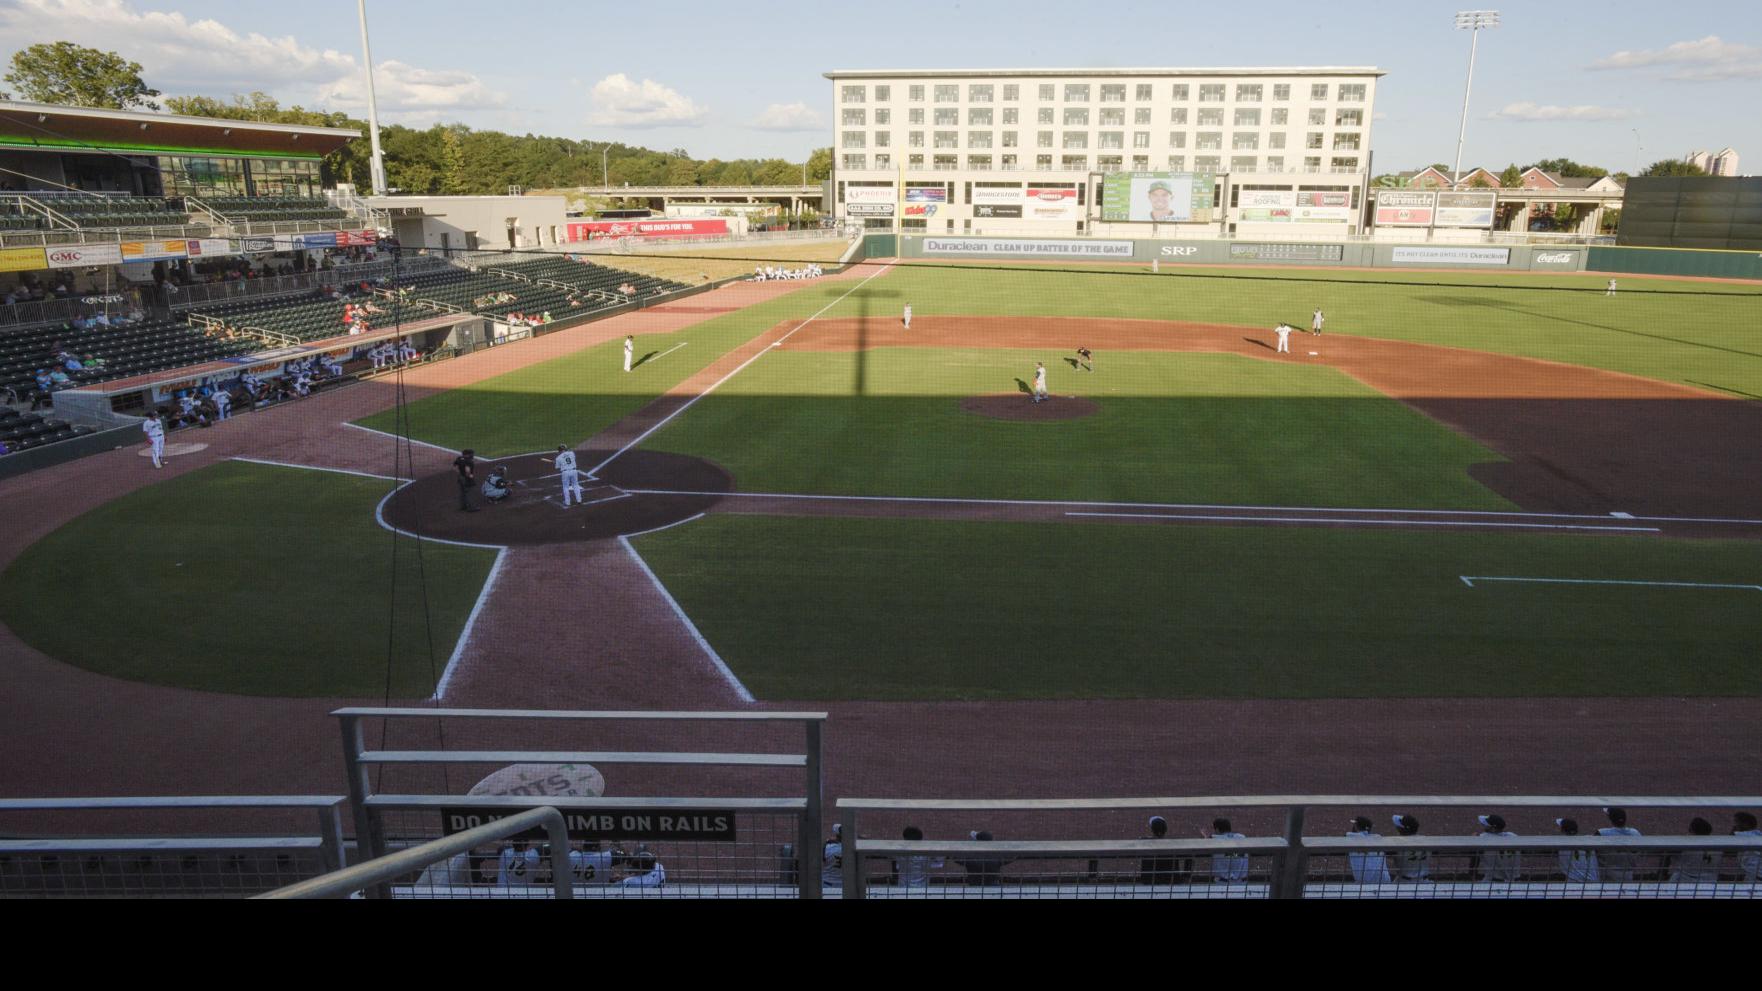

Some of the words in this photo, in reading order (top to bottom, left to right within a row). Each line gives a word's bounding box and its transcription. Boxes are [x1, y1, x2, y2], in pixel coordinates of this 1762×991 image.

[928, 240, 988, 251] Duraclean
[993, 243, 1021, 251] CLEAN
[1023, 244, 1035, 252] UP
[1036, 244, 1069, 252] BATTER
[1085, 245, 1102, 253] THE
[1160, 246, 1198, 256] SRP
[50, 251, 82, 263] GMC
[621, 816, 651, 831] ON
[659, 816, 729, 831] RAILS
